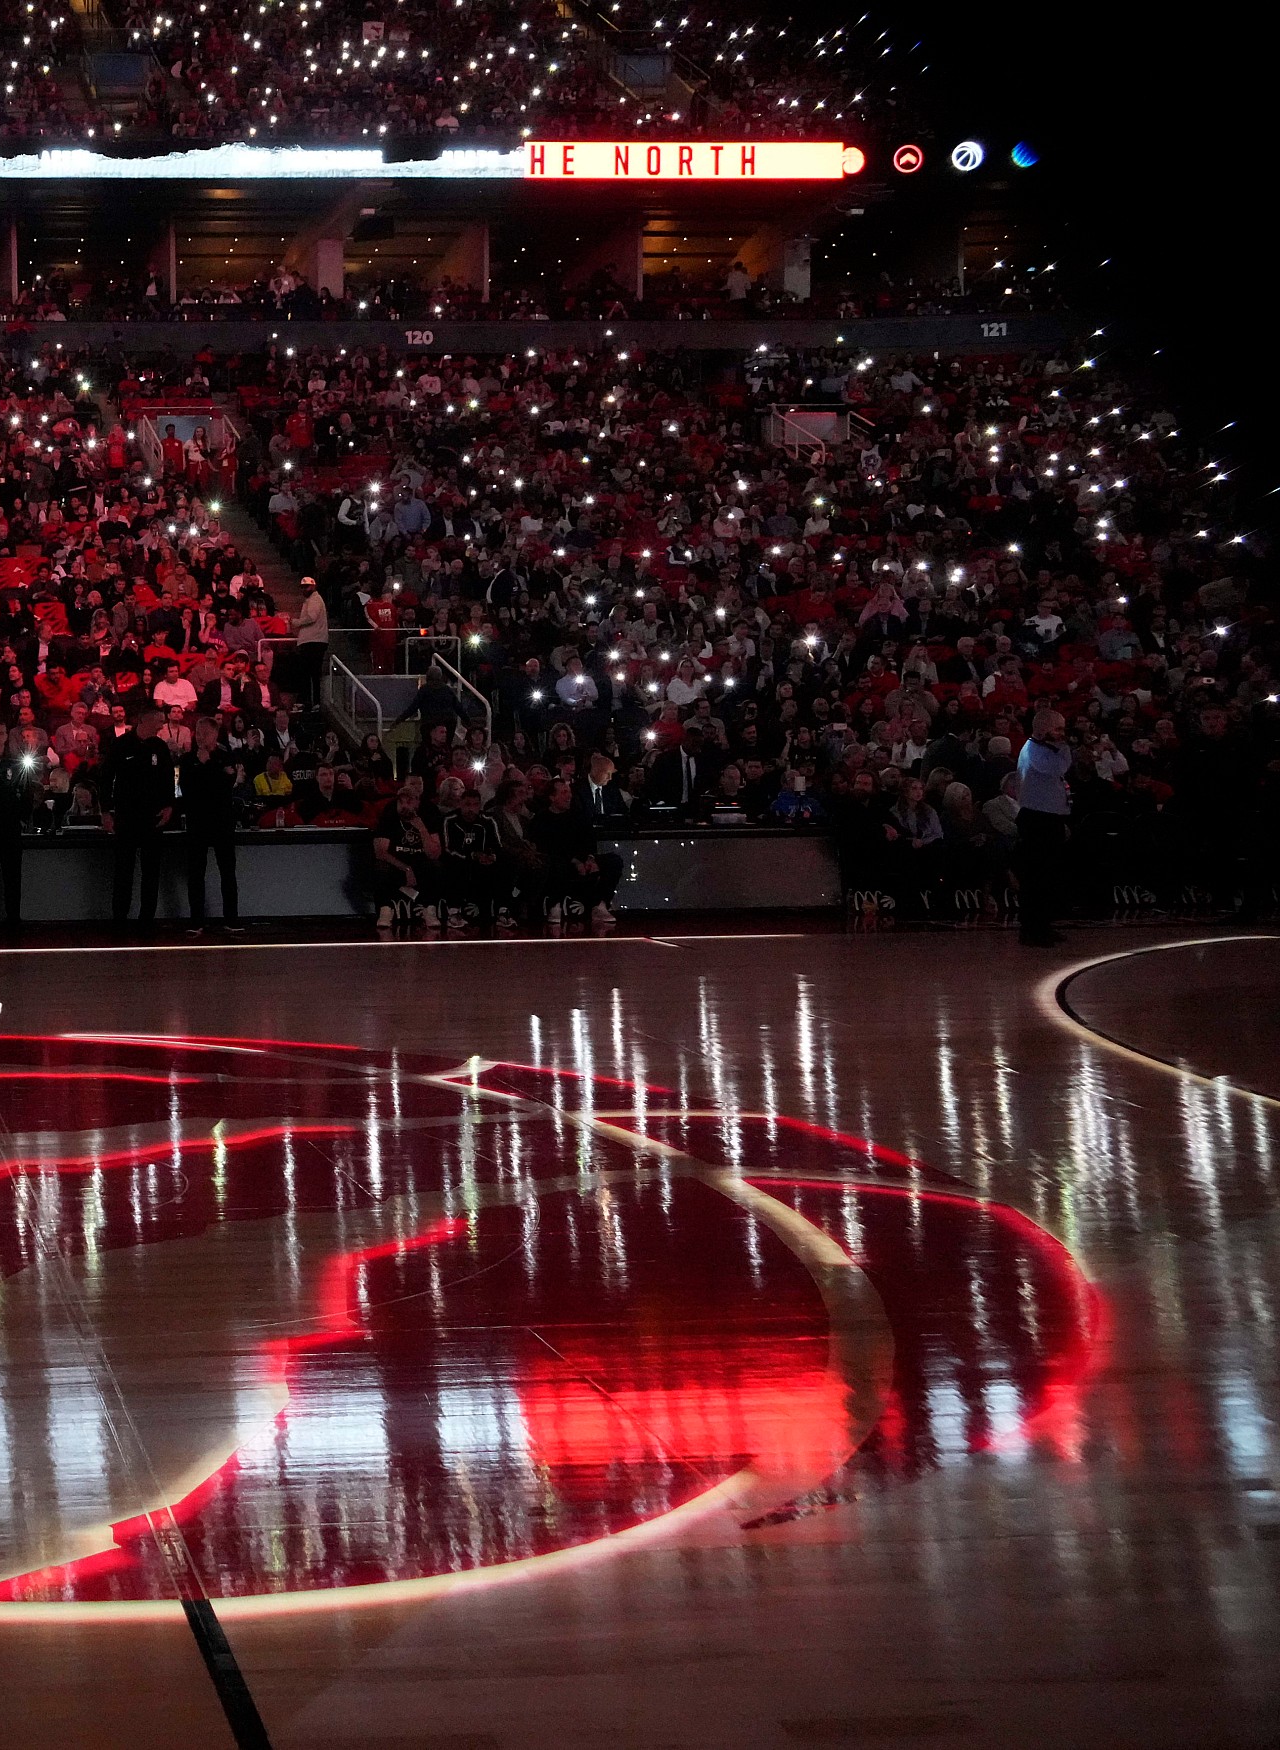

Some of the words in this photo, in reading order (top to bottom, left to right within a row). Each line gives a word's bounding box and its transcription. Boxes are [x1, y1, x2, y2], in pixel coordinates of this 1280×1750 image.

[614, 145, 755, 176] NORTH
[980, 322, 1008, 337] 121
[405, 330, 434, 345] 120
